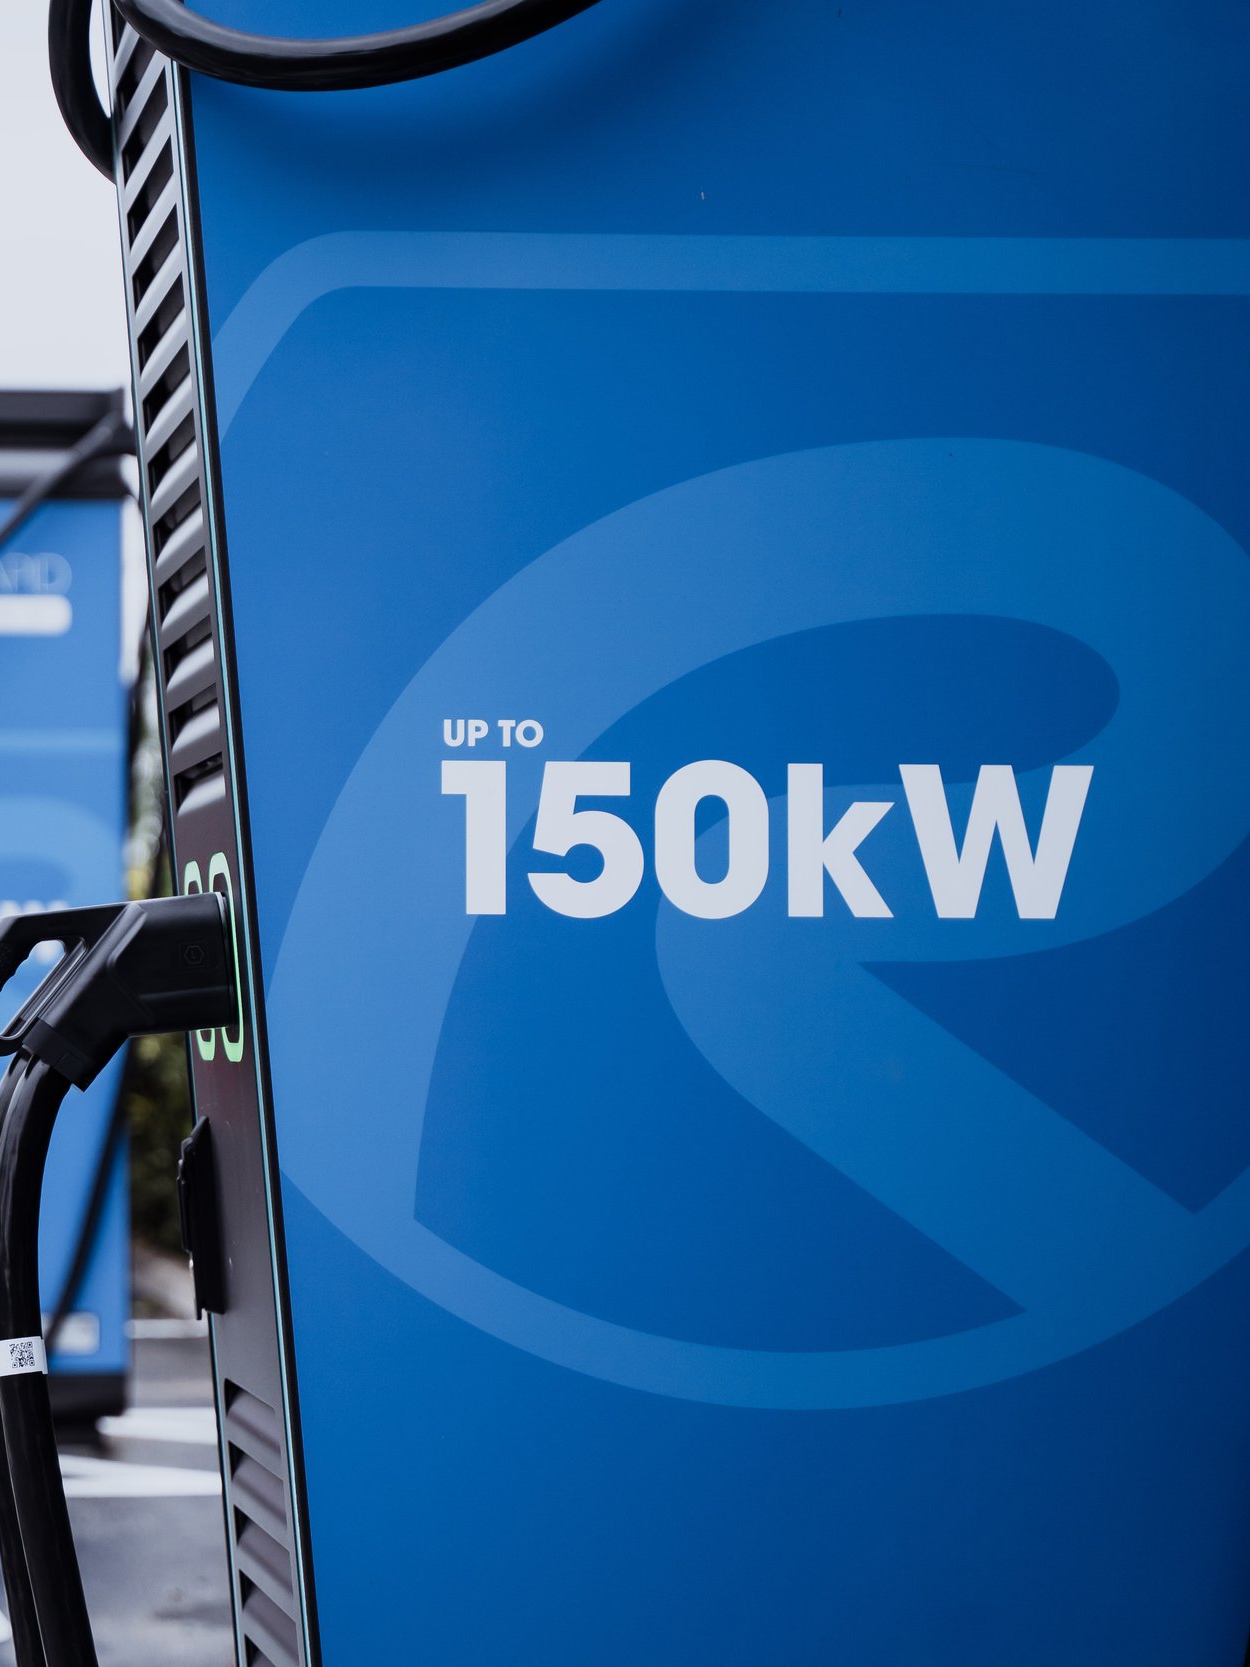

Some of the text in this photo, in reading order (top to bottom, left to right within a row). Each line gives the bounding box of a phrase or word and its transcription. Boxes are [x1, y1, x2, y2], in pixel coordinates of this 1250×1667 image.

[443, 719, 544, 747] UP TO
[441, 759, 1094, 920] 150kW
